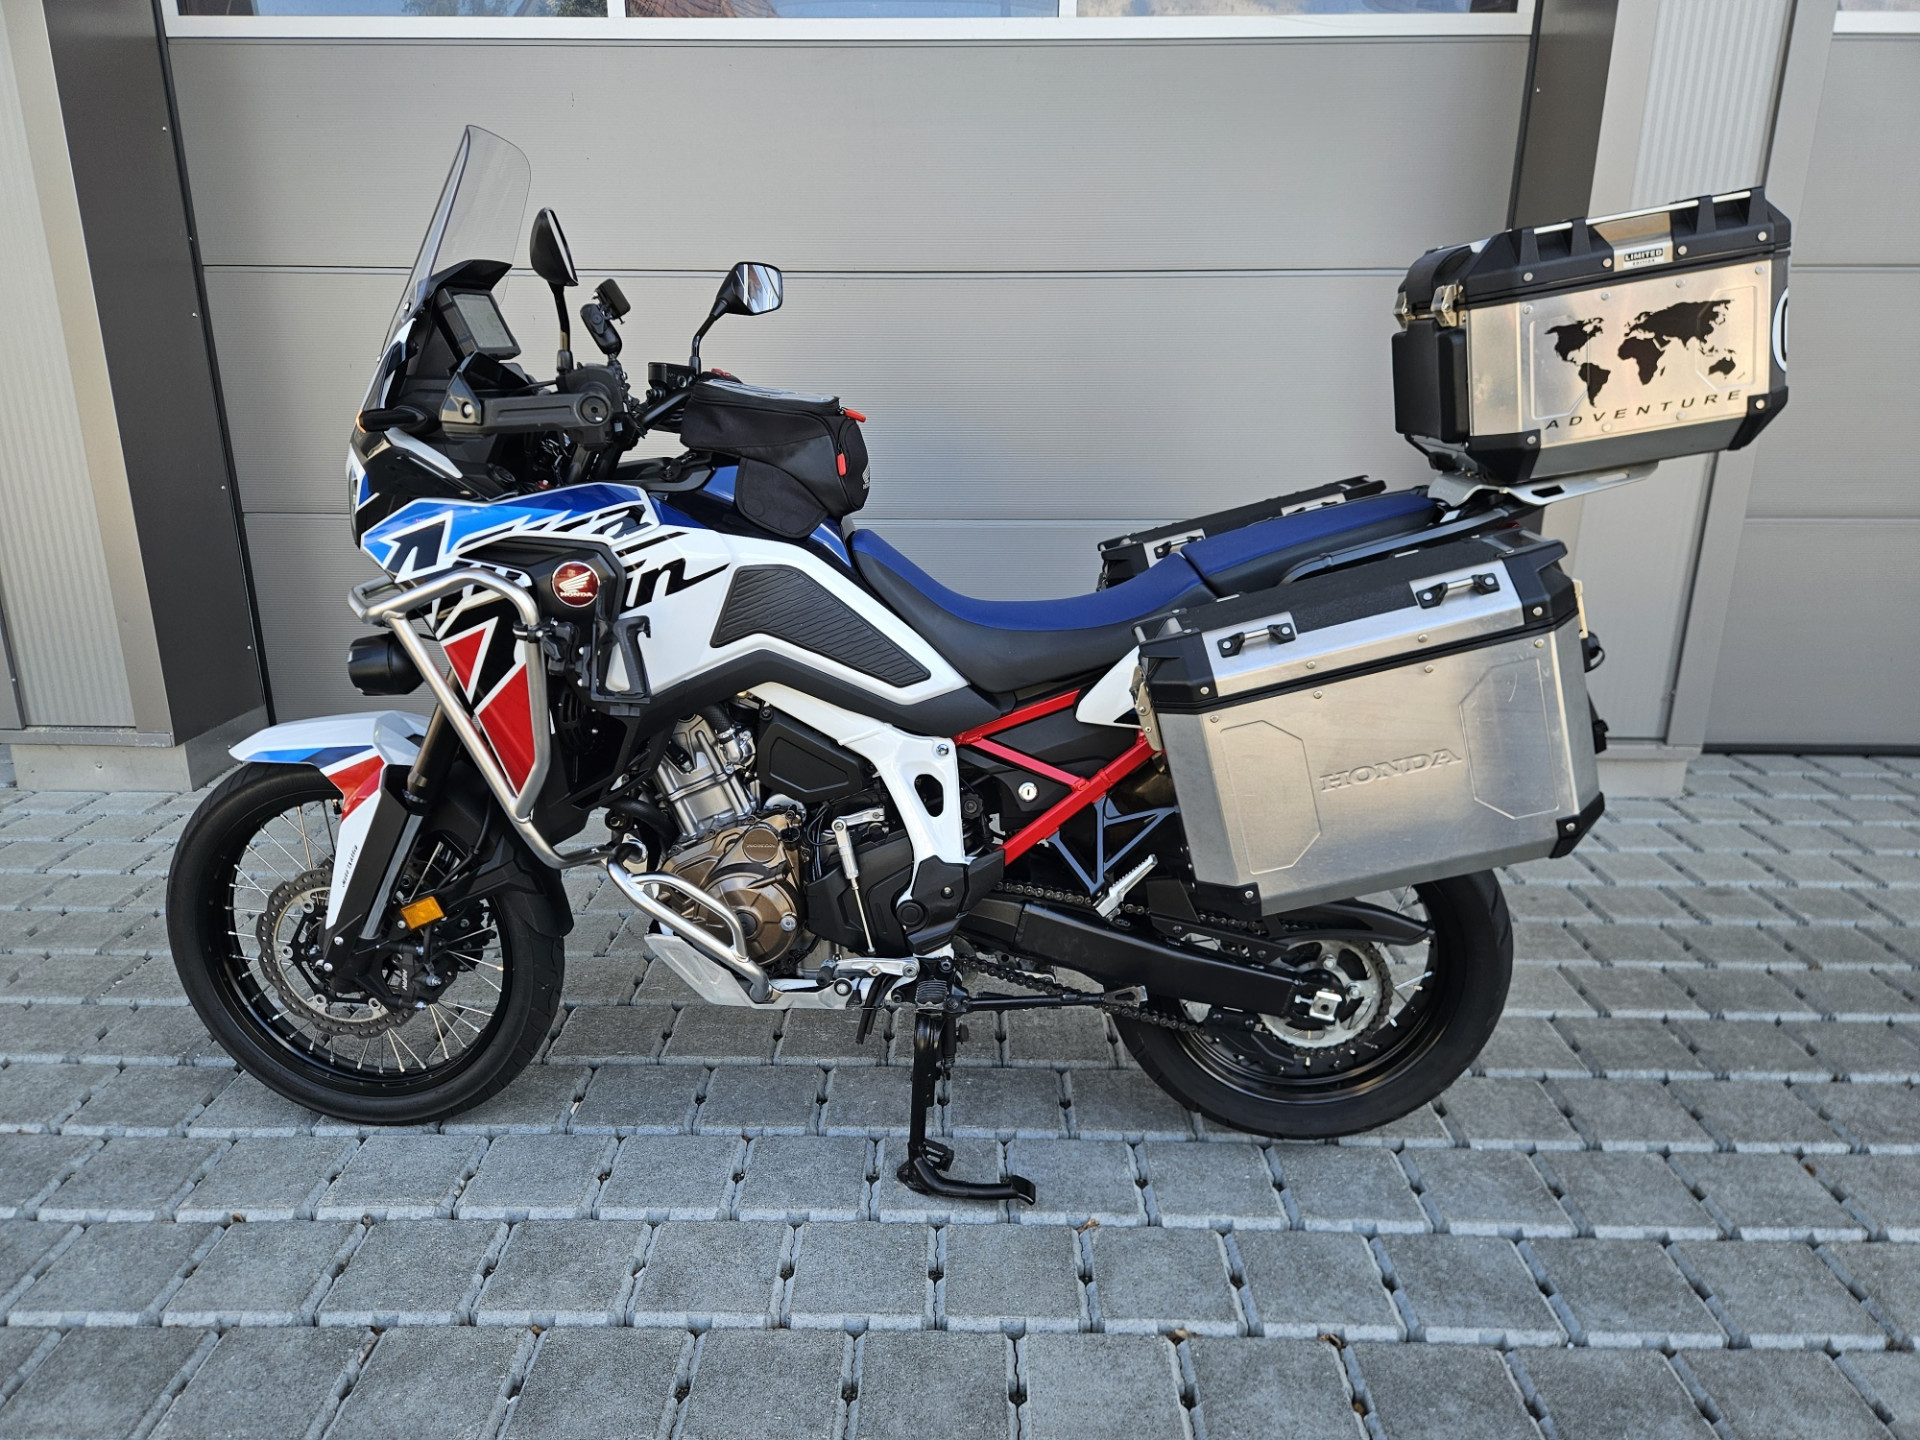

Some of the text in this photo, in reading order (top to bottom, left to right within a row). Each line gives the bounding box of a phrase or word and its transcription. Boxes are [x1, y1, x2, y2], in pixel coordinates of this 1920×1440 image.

[1625, 248, 1663, 262] LIMITED
[1545, 390, 1741, 430] ADVENTURE
[1319, 748, 1462, 793] HONDA
